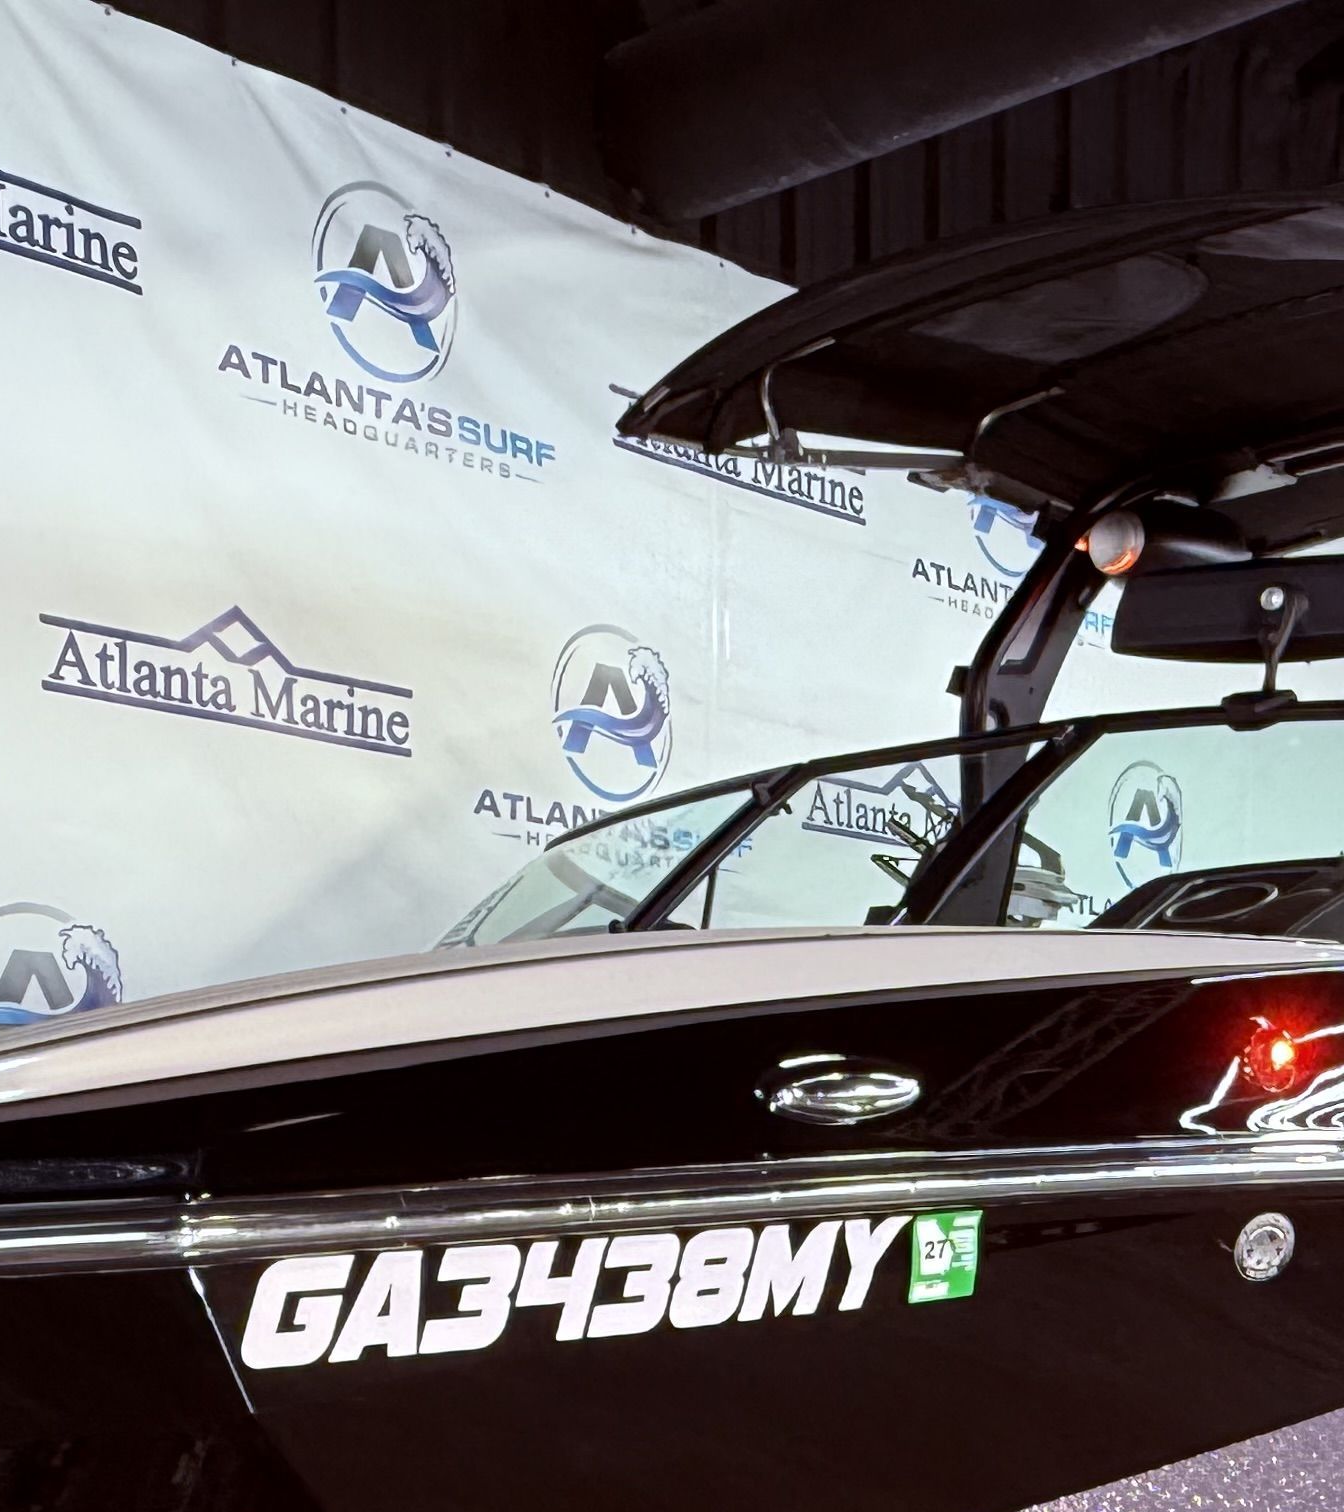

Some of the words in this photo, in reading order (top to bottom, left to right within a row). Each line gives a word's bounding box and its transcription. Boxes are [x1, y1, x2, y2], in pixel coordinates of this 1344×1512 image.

[282, 399, 510, 478] HEADQUARTERS
[48, 629, 236, 712] Atlanta
[248, 668, 410, 745] Marine
[240, 1215, 912, 1370] GA3438MY
[924, 1239, 948, 1260] 27
